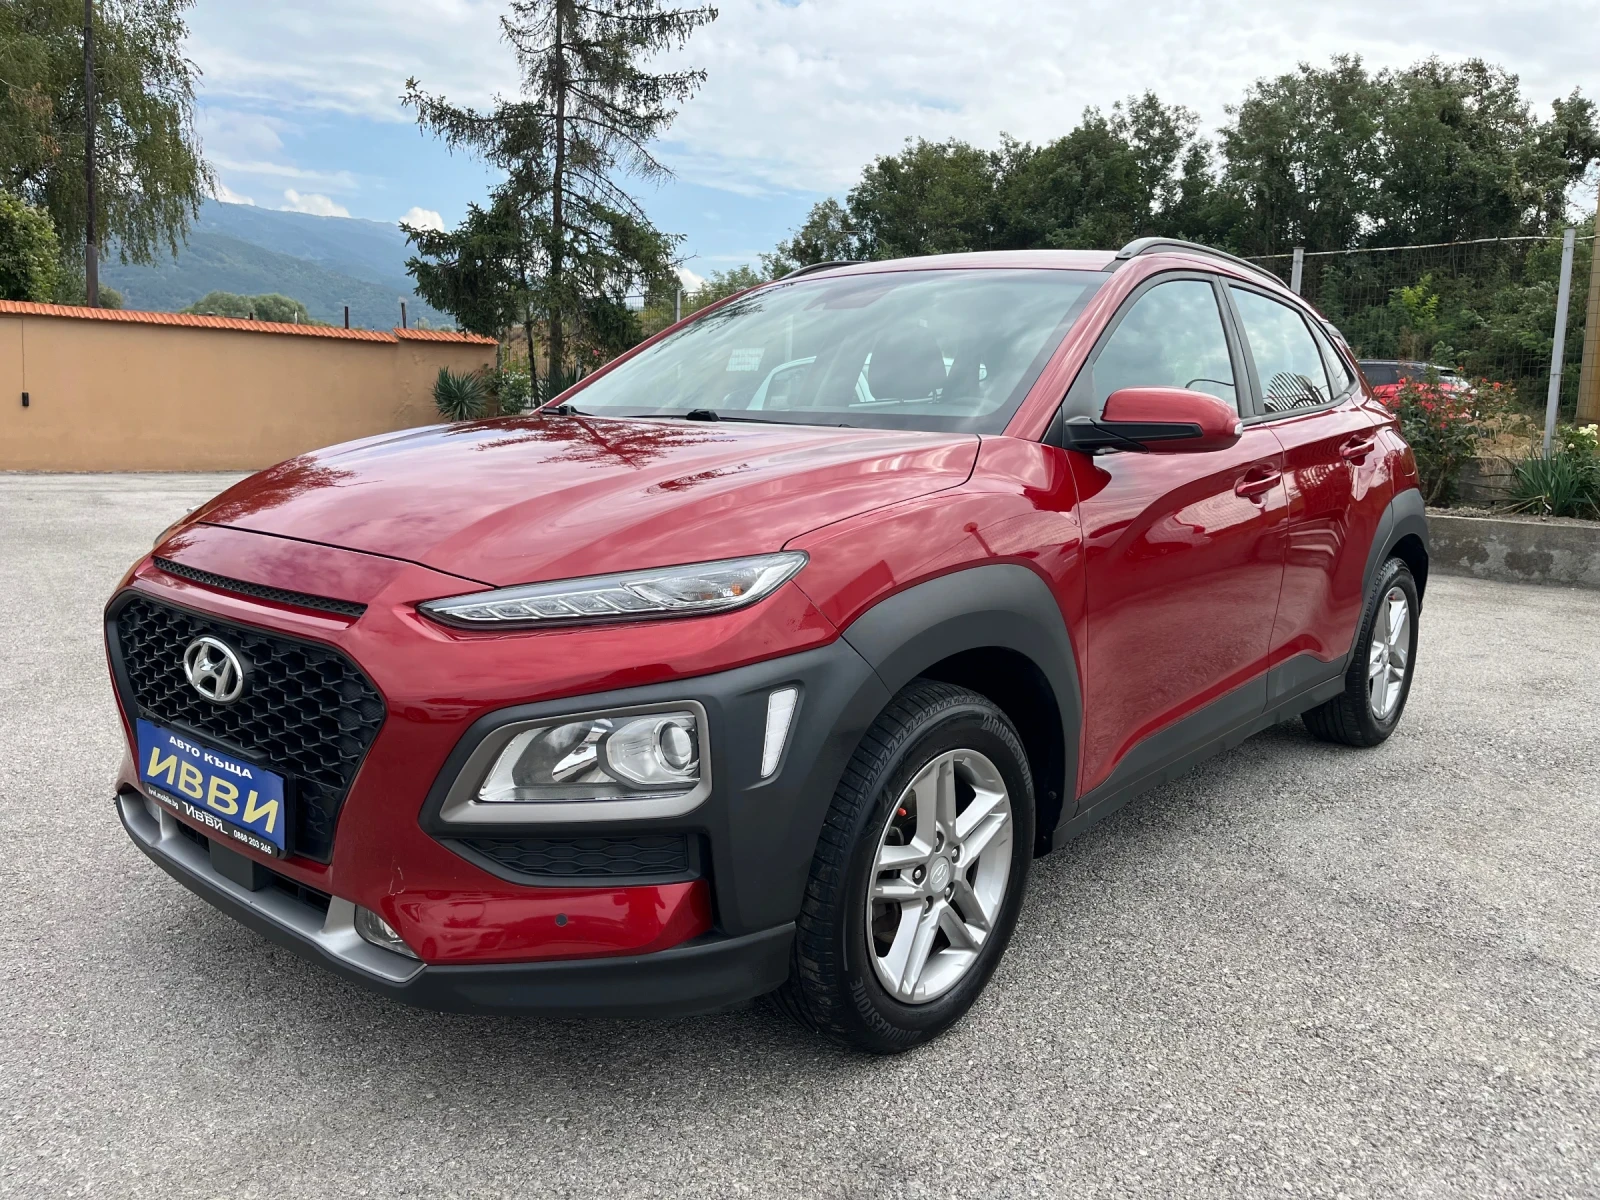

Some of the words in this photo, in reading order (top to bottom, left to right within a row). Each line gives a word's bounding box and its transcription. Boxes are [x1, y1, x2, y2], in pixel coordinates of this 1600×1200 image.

[147, 746, 279, 833] ИВВИ
[169, 736, 200, 757] АВТО
[204, 752, 253, 780] КЪЩА
[980, 714, 1034, 794] BRIDGESTONE
